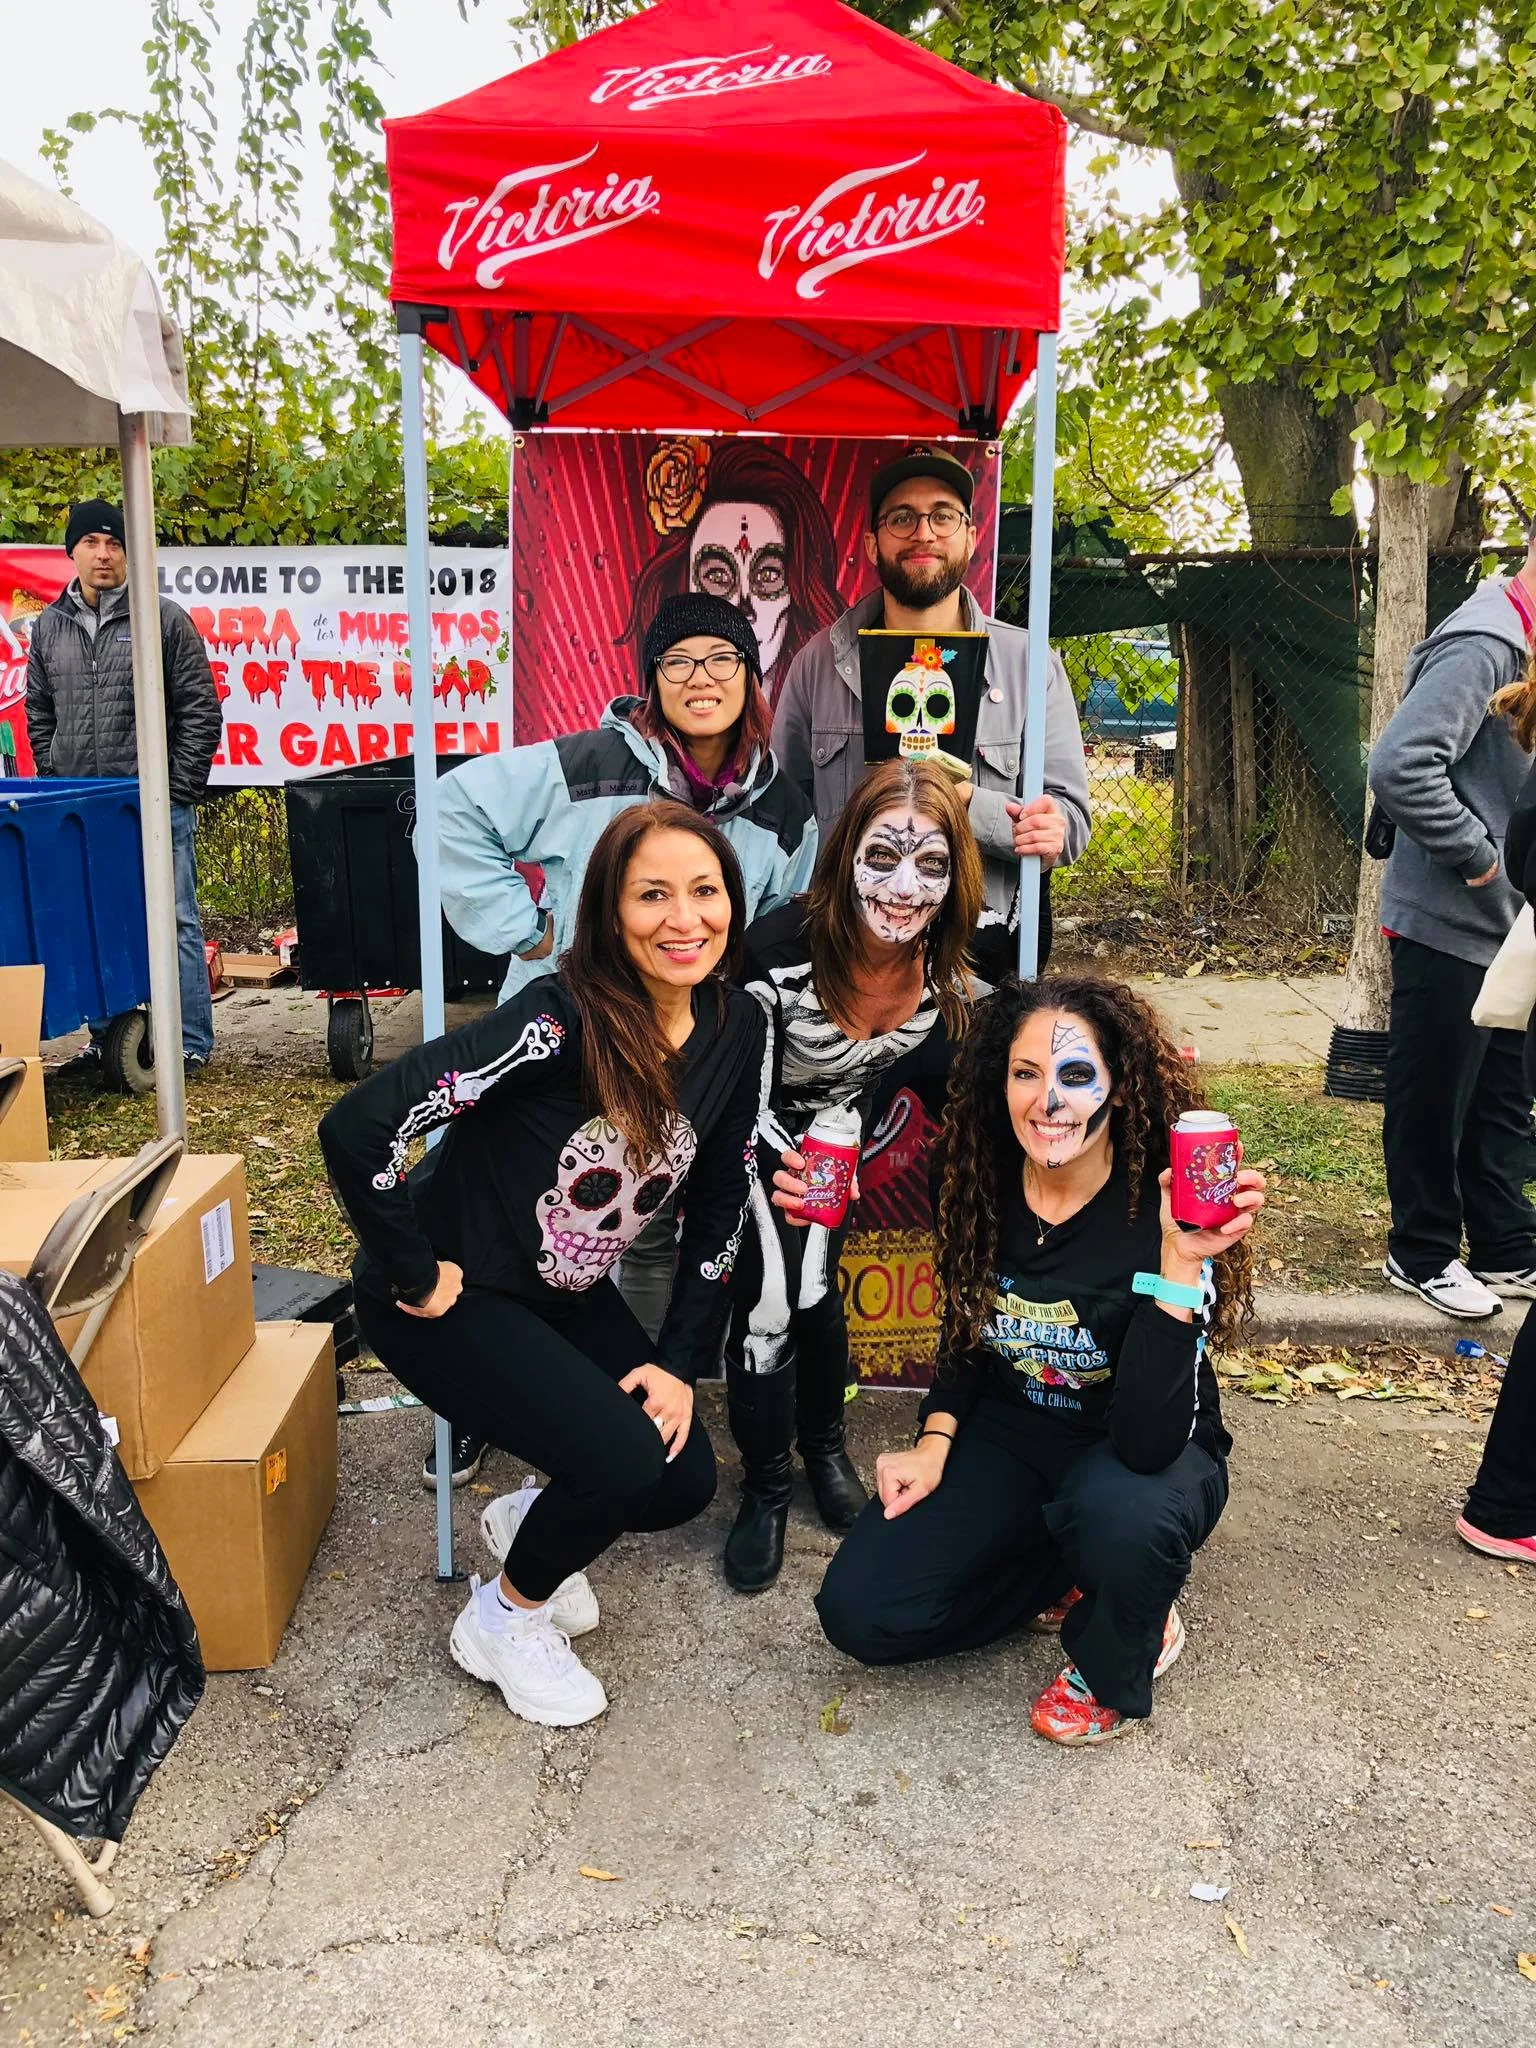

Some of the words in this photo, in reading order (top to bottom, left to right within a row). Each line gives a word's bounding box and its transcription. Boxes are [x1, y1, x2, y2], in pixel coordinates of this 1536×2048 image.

[590, 43, 832, 111] Victoria
[438, 141, 661, 289] Victoria
[758, 149, 985, 299] Victoria
[157, 565, 268, 595] LCOME
[279, 565, 322, 594] TO
[344, 565, 404, 594] THE
[189, 606, 300, 660] RERA
[313, 613, 329, 627] de
[316, 629, 335, 641] los
[339, 610, 501, 650] MUETOS
[242, 661, 289, 709] OF
[301, 660, 382, 712] THE
[393, 660, 493, 712] DAD
[1028, 1305, 1038, 1317] OF
[1038, 1306, 1054, 1318] THE
[1053, 1304, 1074, 1317] DEAD
[981, 1314, 1095, 1351] ARRERA
